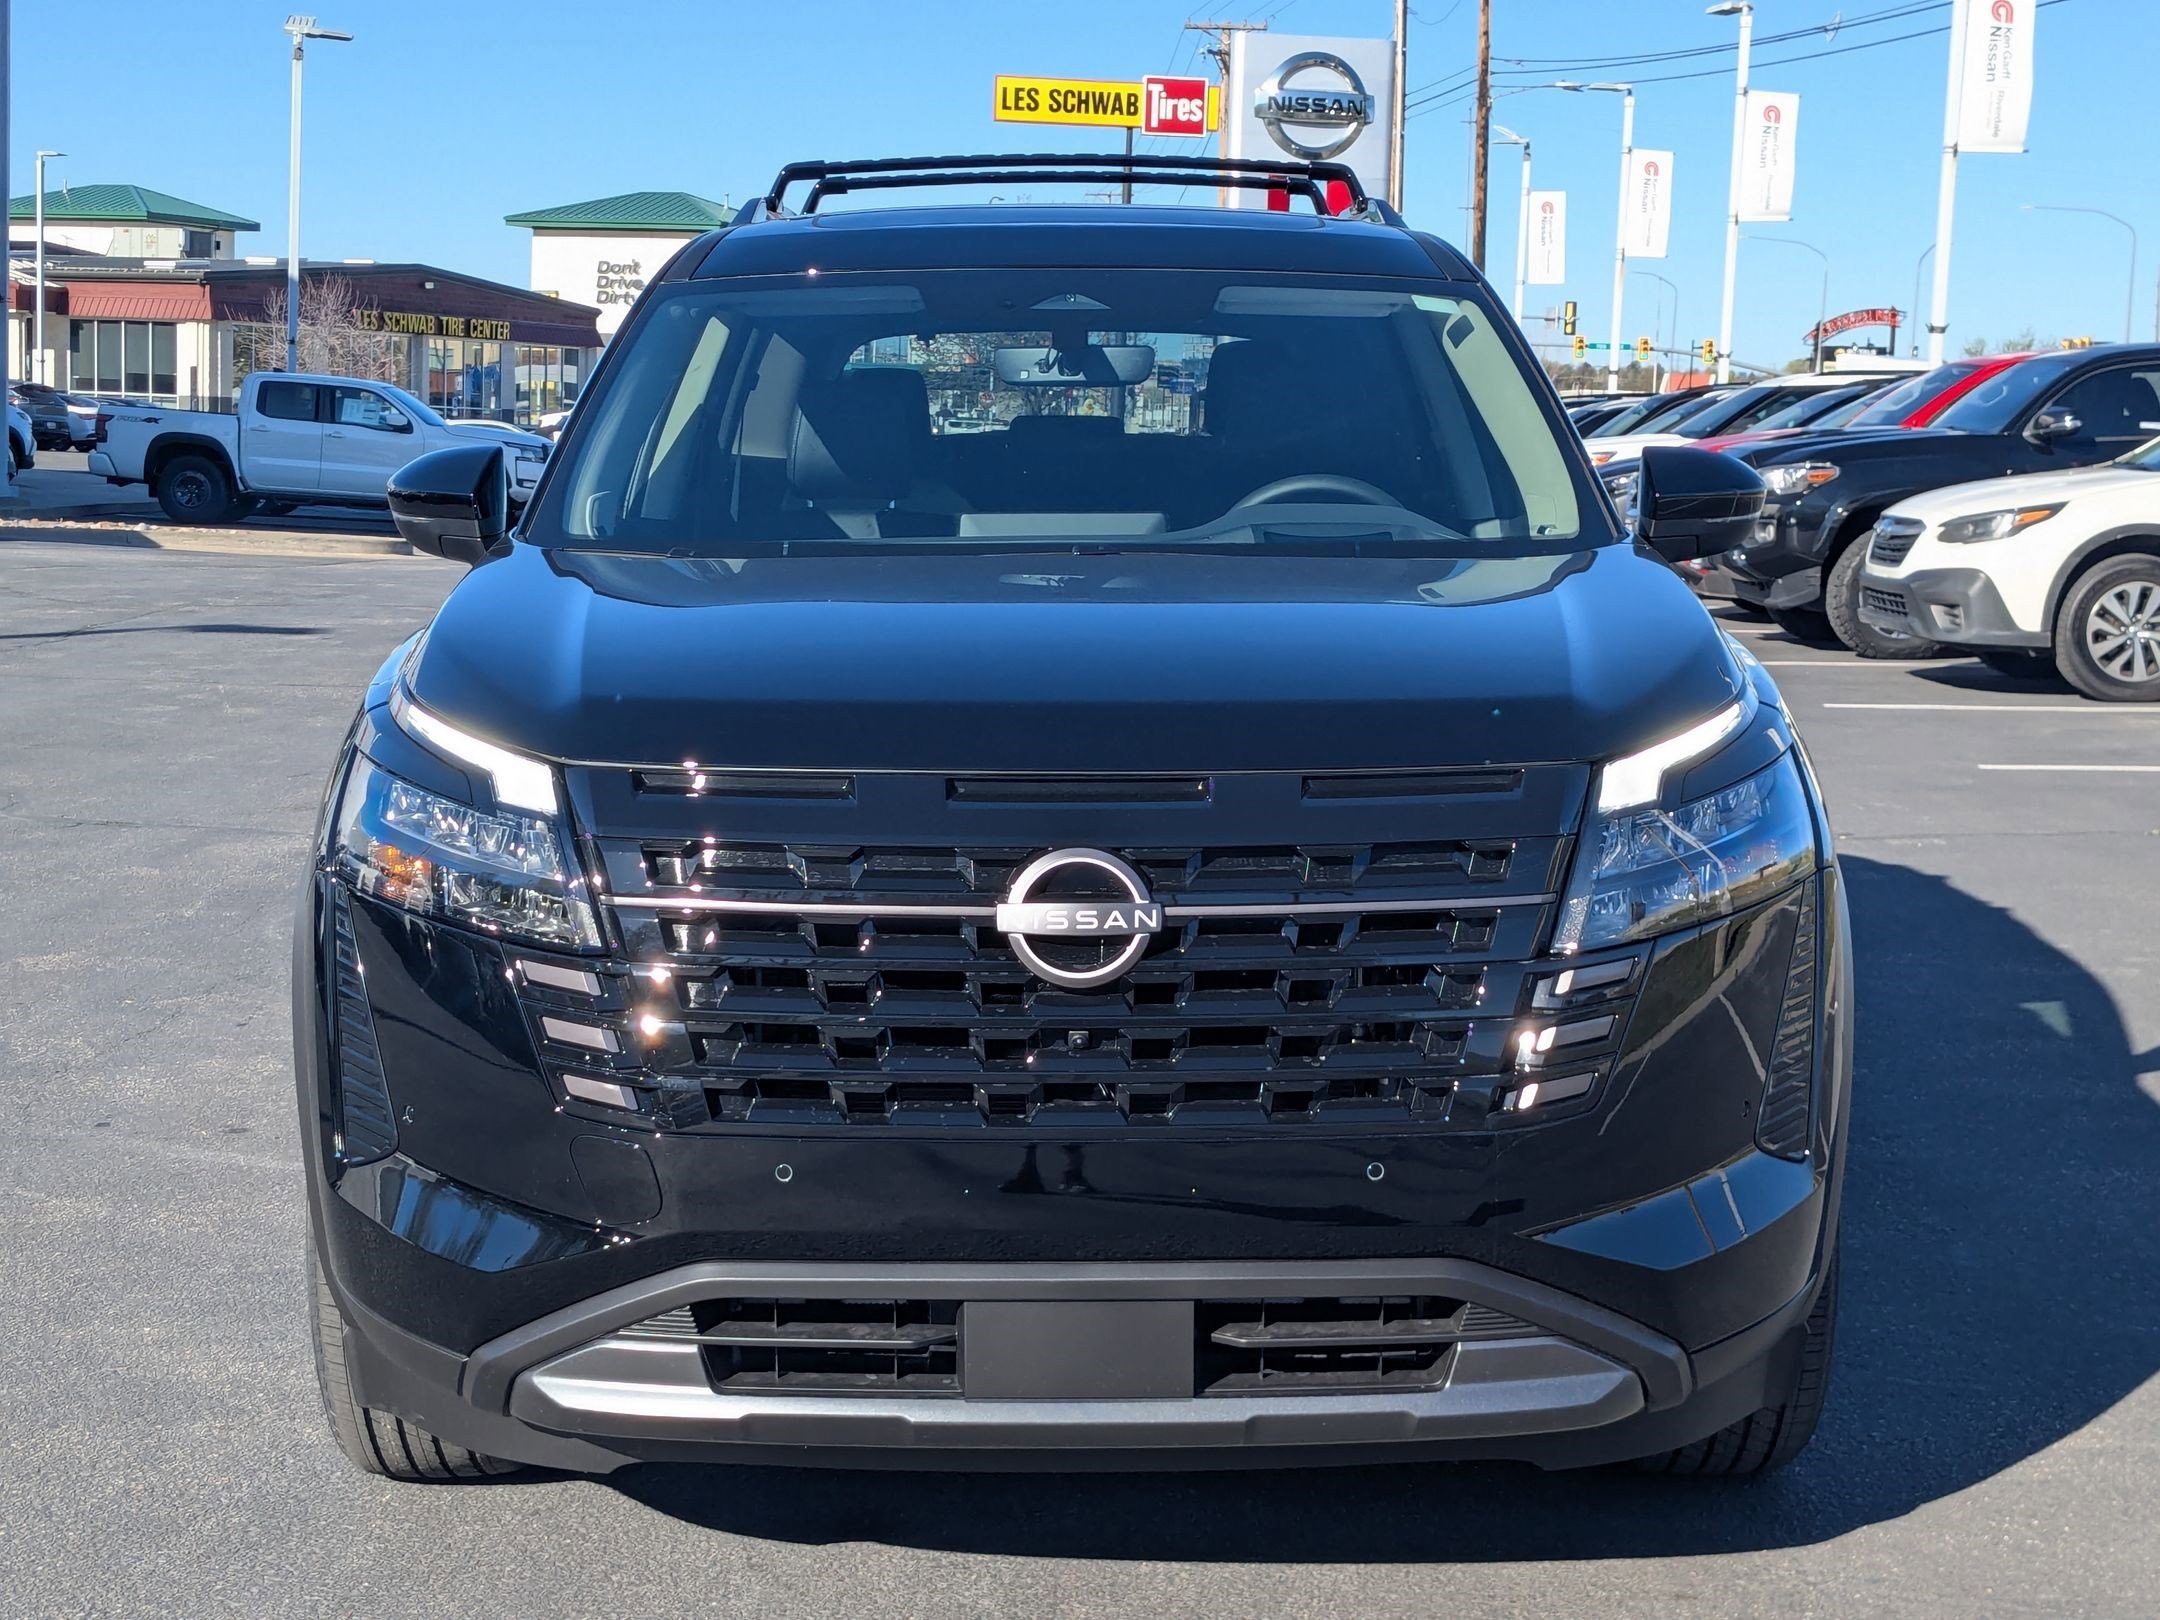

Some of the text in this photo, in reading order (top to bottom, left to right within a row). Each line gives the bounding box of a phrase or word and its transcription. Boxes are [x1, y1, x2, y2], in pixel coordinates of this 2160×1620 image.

[1985, 25, 2003, 83] Nissan
[2001, 26, 2013, 80] Ken Garff
[1001, 82, 1204, 129] LES SCHWAB Tires
[1267, 95, 1364, 116] NISSAN
[1759, 125, 1772, 169] Nissan
[597, 275, 646, 290] Drive
[355, 308, 511, 341] LES SCHWAB TIRE CENTER
[1002, 909, 1157, 930] NISSAN
